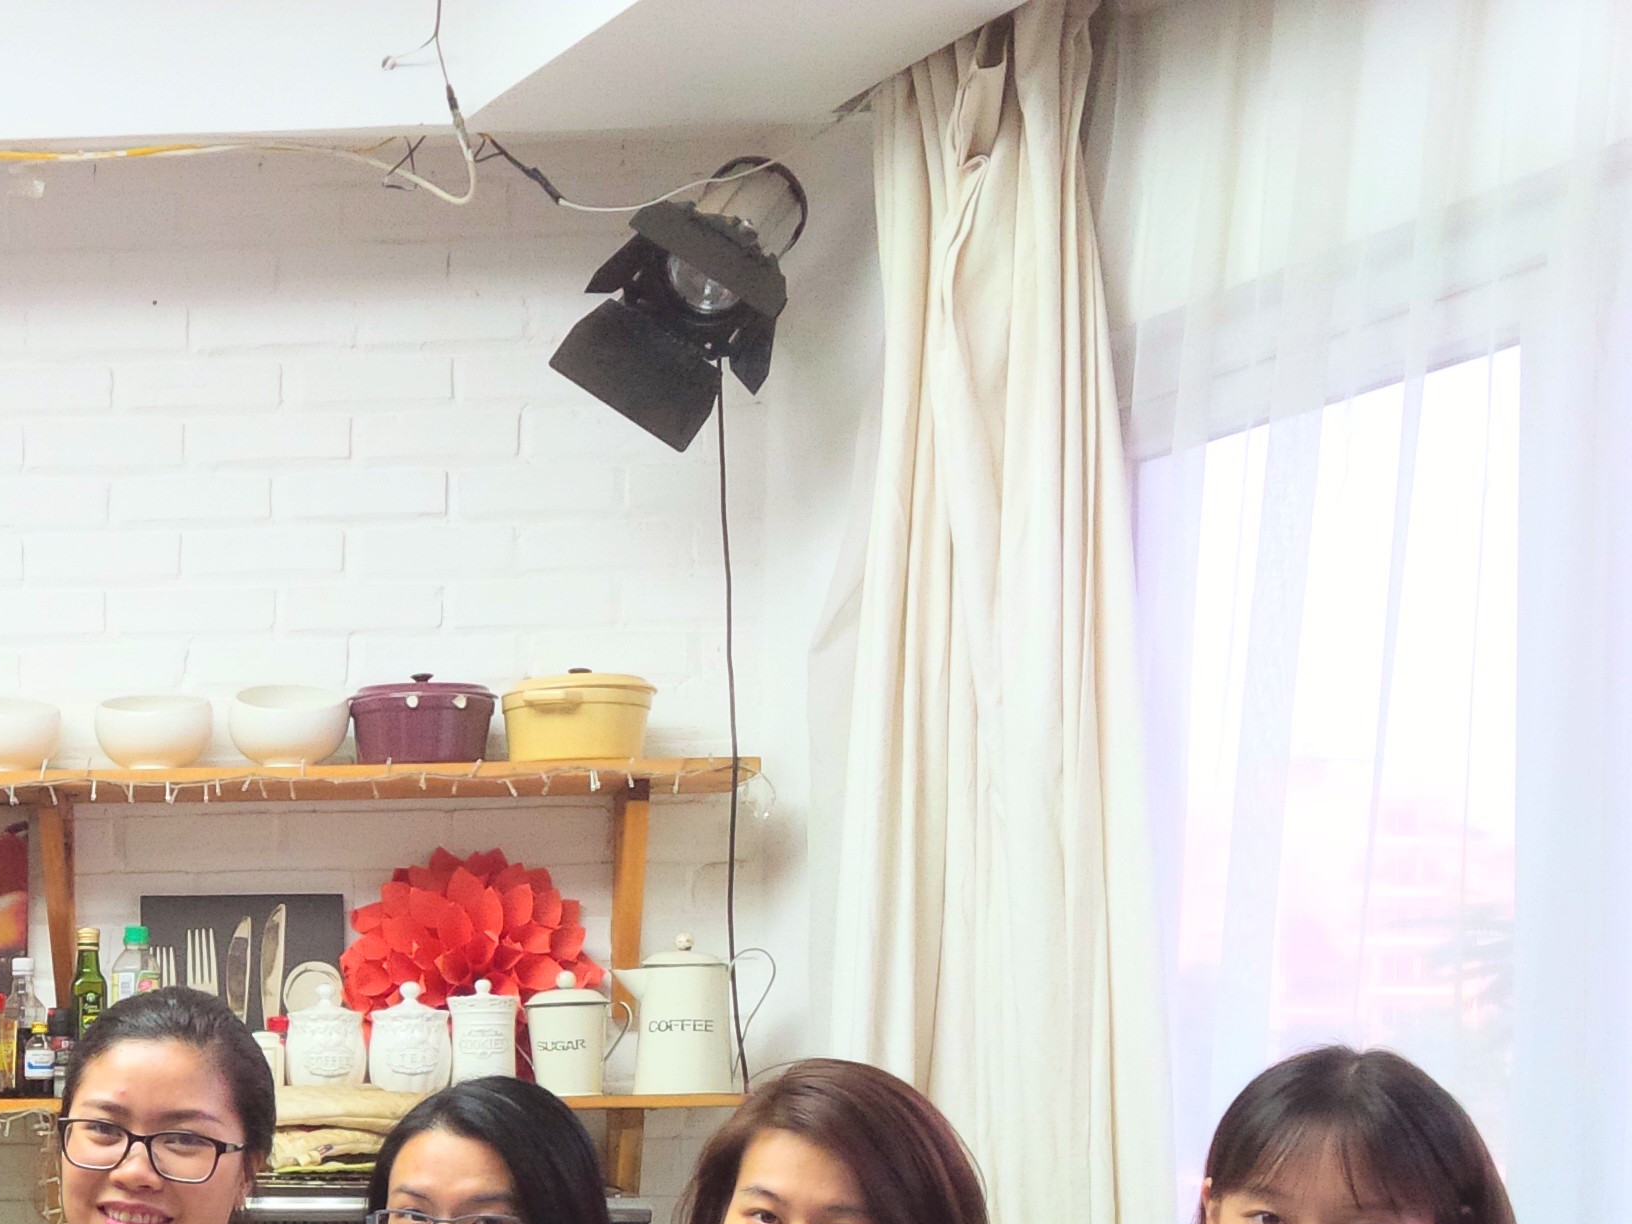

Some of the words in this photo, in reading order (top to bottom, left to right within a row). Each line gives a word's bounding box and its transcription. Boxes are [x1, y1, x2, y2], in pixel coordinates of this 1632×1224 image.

[648, 1018, 715, 1034] COFFEE
[458, 1038, 507, 1051] COOKIES
[536, 1038, 587, 1053] SUGAR
[308, 1054, 352, 1067] COFFEE
[398, 1053, 433, 1065] TEA
